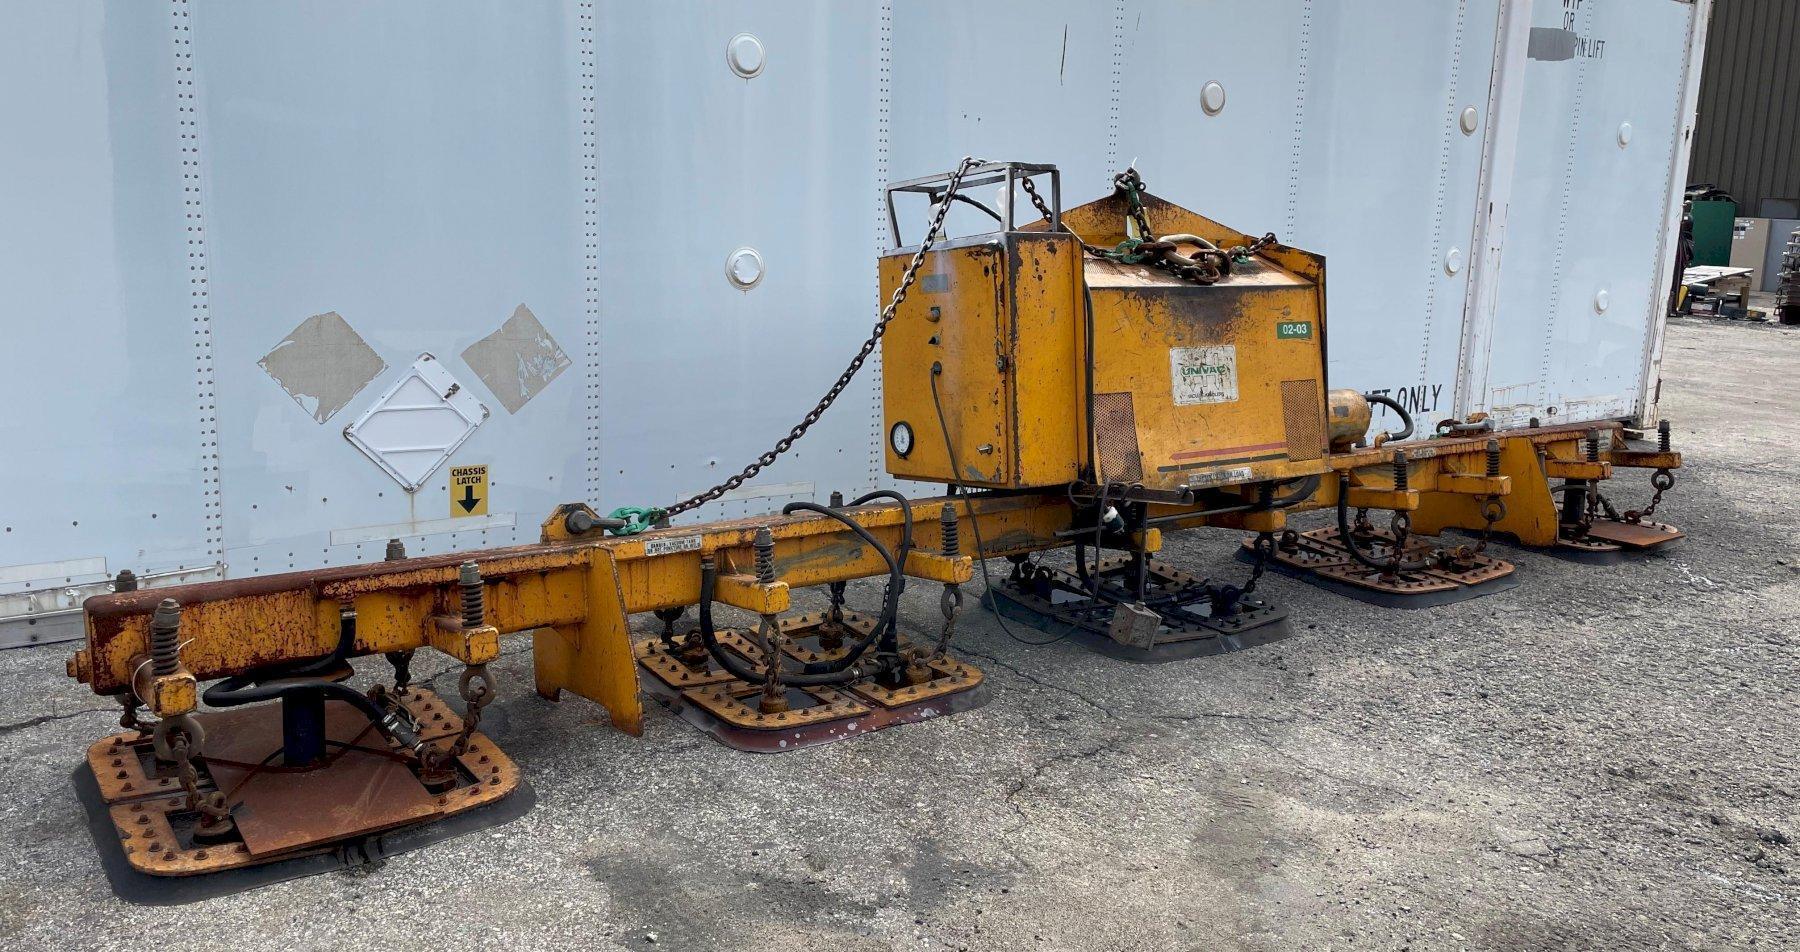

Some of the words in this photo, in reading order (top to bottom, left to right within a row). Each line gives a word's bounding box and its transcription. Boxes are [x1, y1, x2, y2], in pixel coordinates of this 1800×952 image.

[1564, 11, 1574, 31] OR
[1588, 39, 1605, 59] LIFT
[1282, 323, 1307, 335] 02-03
[1397, 383, 1442, 414] ONLY
[452, 466, 486, 477] CHASSIS
[456, 476, 482, 485] LATCH
